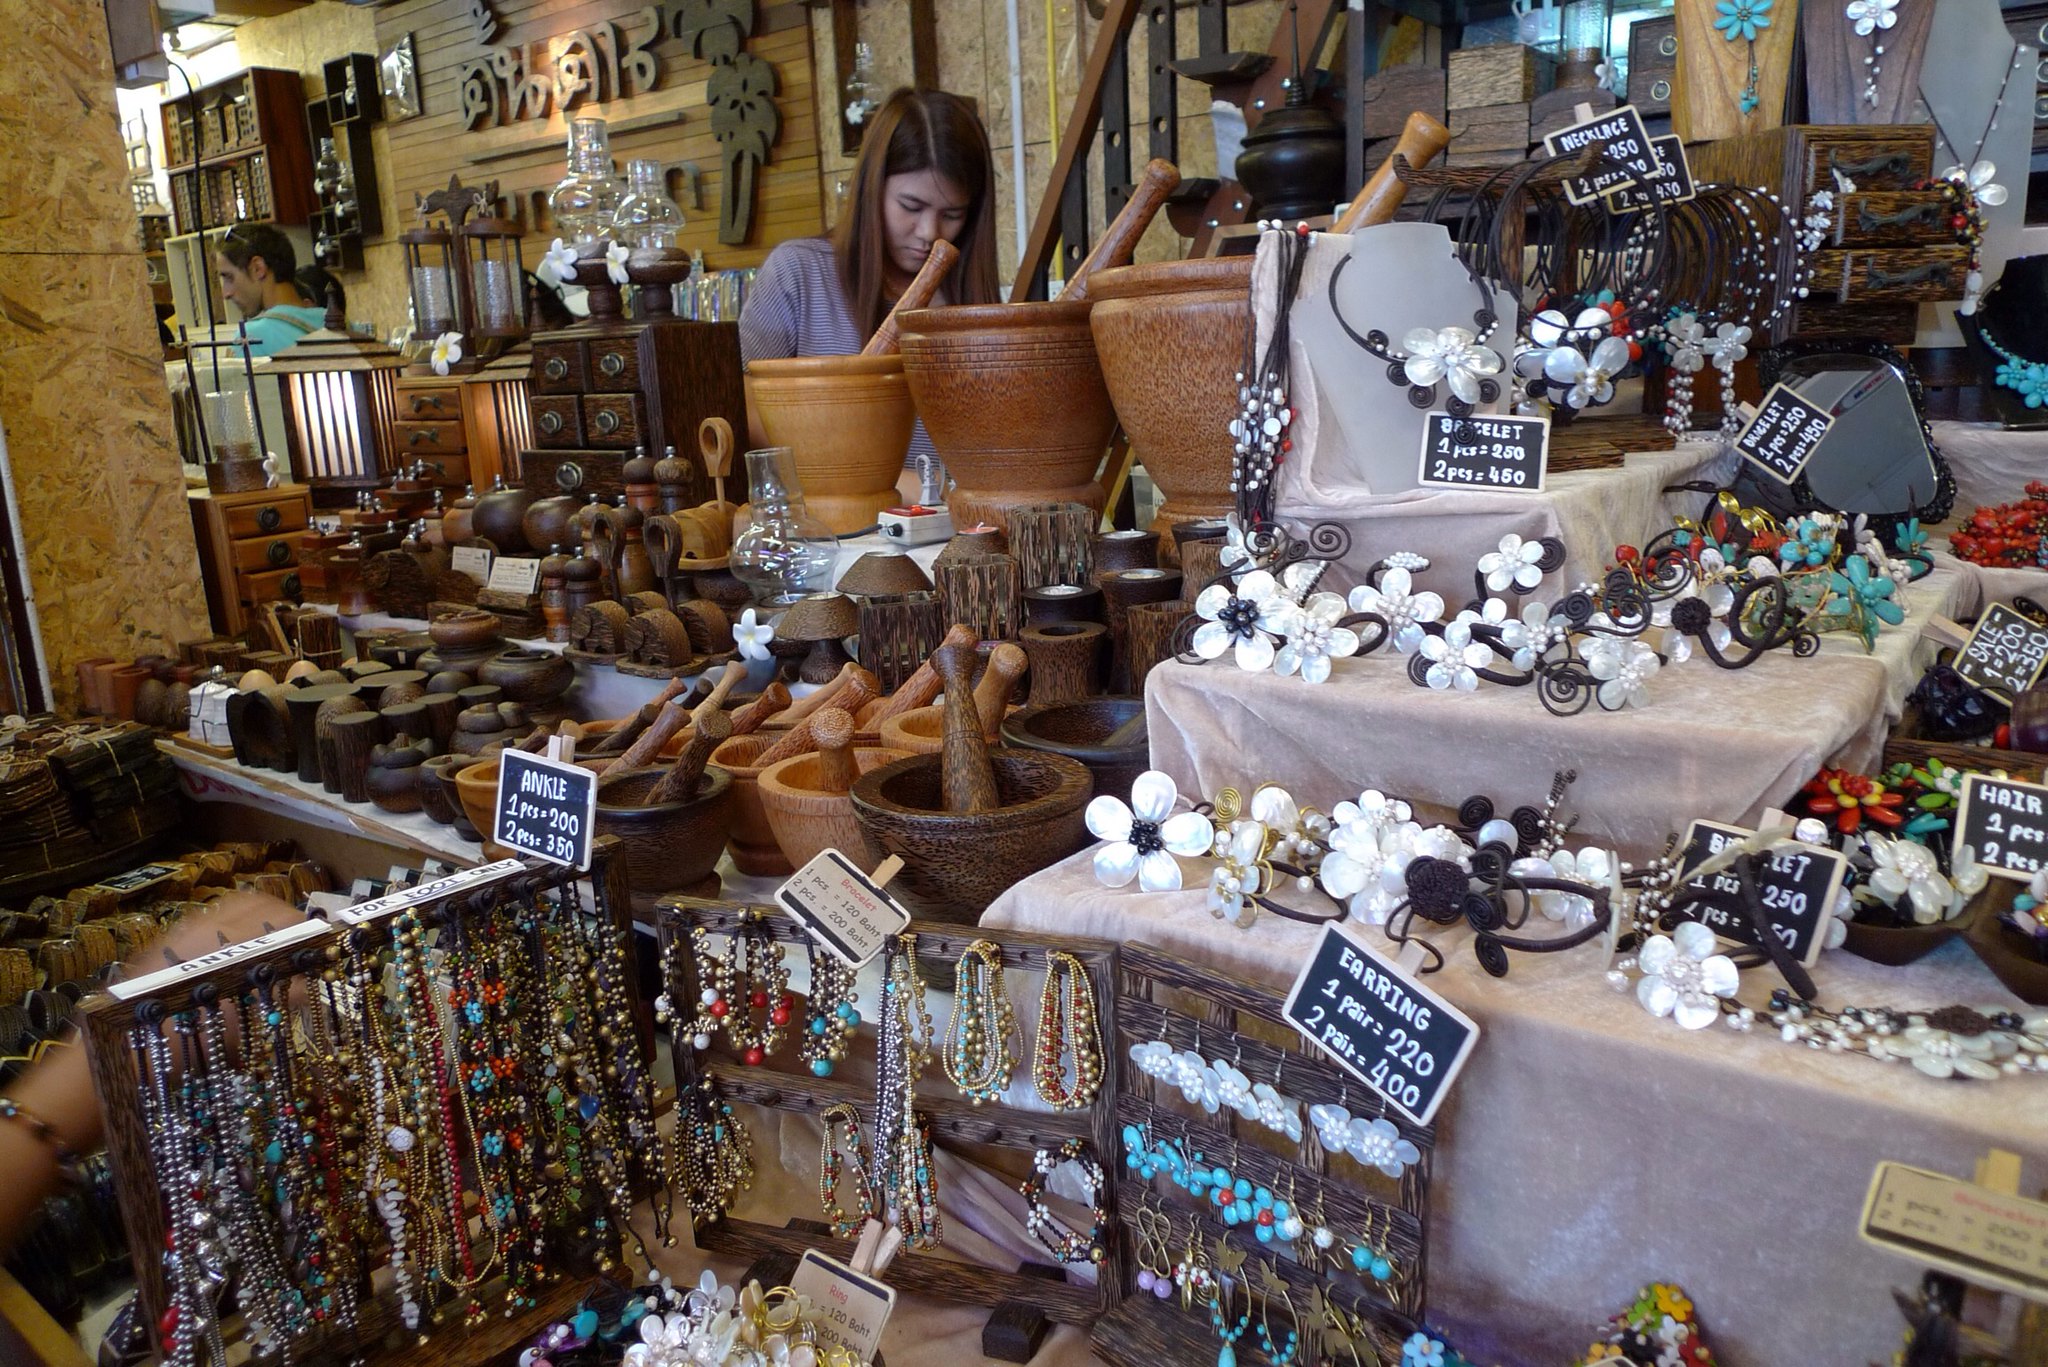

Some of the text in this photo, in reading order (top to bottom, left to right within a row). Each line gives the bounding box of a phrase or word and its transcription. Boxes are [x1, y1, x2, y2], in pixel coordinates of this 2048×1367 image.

[1609, 139, 1639, 159] 250
[1578, 178, 1591, 194] 2
[1780, 407, 1807, 433] 250
[1798, 418, 1826, 442] 450
[1437, 437, 1450, 454] 1
[1491, 443, 1525, 461] 250
[1489, 466, 1526, 485] 450
[1967, 620, 2004, 663] SALE
[1994, 624, 2026, 663] 200
[2005, 676, 2027, 692] 2
[2016, 632, 2048, 671] 350
[521, 769, 568, 801] ANKLE
[1979, 783, 2043, 815] HAIR
[505, 793, 519, 816] 1
[549, 807, 579, 836] 200
[1985, 812, 2004, 833] 1
[505, 820, 516, 841] 2
[546, 834, 574, 861] 350
[1982, 841, 2000, 863] 2
[349, 861, 514, 917] FOR FOOT ONLY
[792, 878, 803, 887] 2
[828, 911, 848, 929] 200
[806, 868, 814, 876] 1
[841, 900, 861, 918] 120
[841, 879, 877, 912] Bracelet
[1762, 885, 1807, 915] 250
[180, 936, 277, 972] ANKLE
[1339, 947, 1432, 1031] EARRING
[1321, 979, 1340, 1000] 1
[1385, 1028, 1435, 1077] 220
[1304, 1005, 1326, 1029] 2
[1370, 1058, 1421, 1107] 400
[829, 1284, 849, 1304] Ring
[829, 1307, 847, 1325] 120
[821, 1327, 839, 1344] 200
